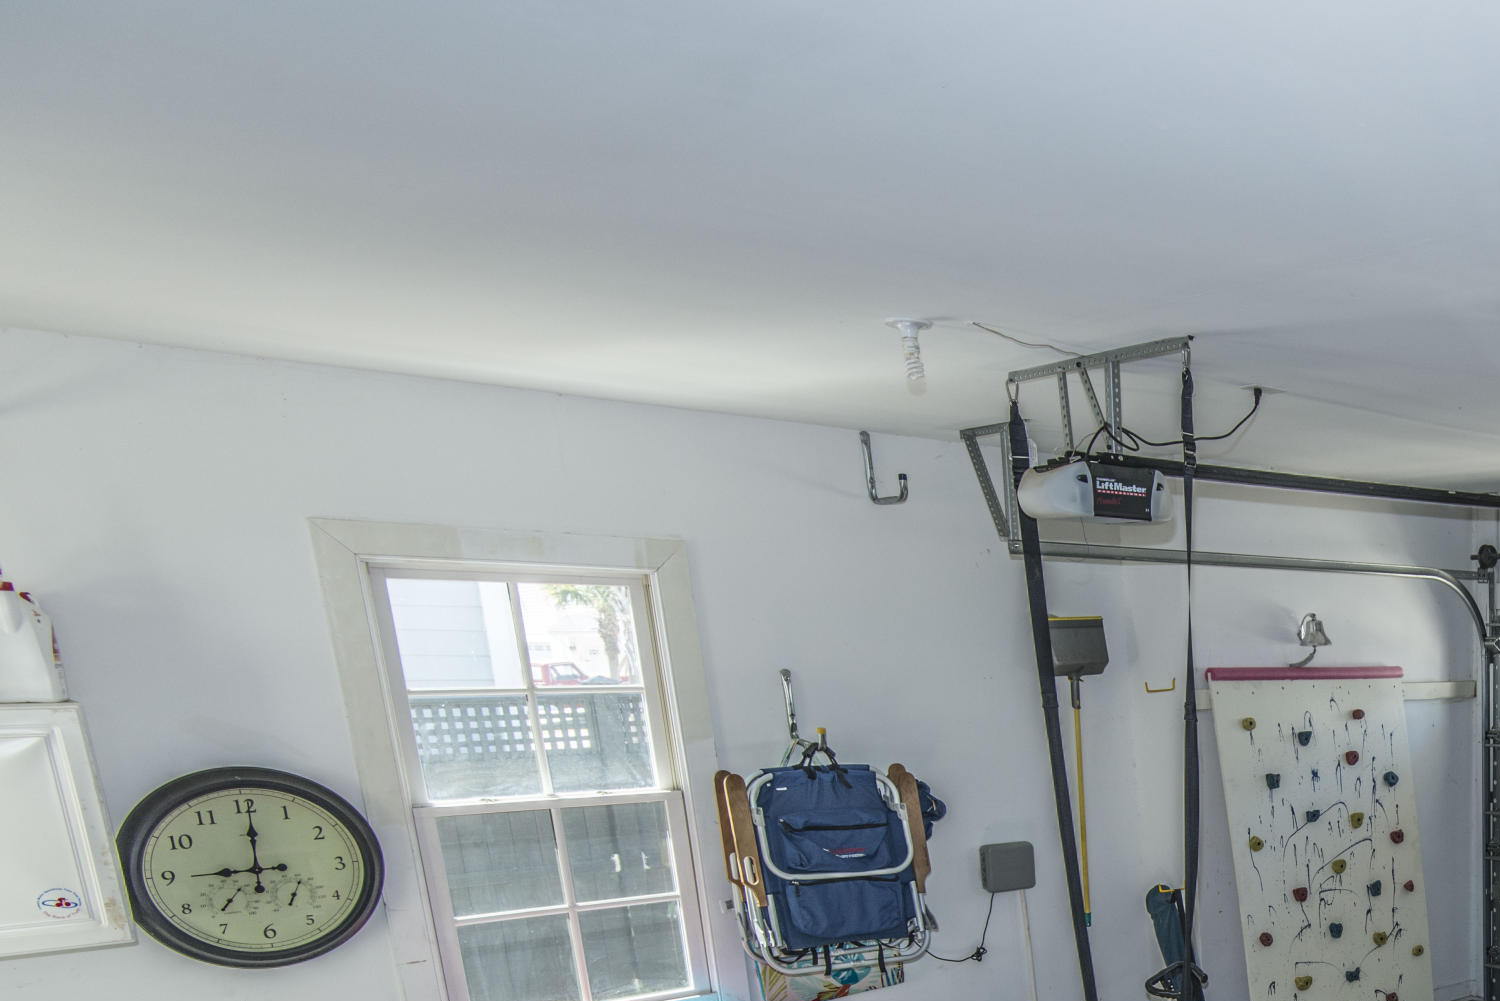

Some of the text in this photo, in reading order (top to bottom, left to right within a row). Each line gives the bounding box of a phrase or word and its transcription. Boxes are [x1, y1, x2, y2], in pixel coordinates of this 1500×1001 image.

[1096, 480, 1147, 493] LiftMaster
[233, 798, 257, 815] 12
[280, 805, 291, 821] 1
[194, 809, 217, 826] 11
[312, 826, 326, 841] 2
[168, 834, 193, 851] 10
[334, 856, 347, 871] 3
[161, 870, 176, 887] 9
[331, 889, 341, 900] 4
[181, 903, 193, 915] 8
[306, 914, 315, 926] 5
[219, 923, 229, 935] 7
[263, 924, 277, 939] 6
